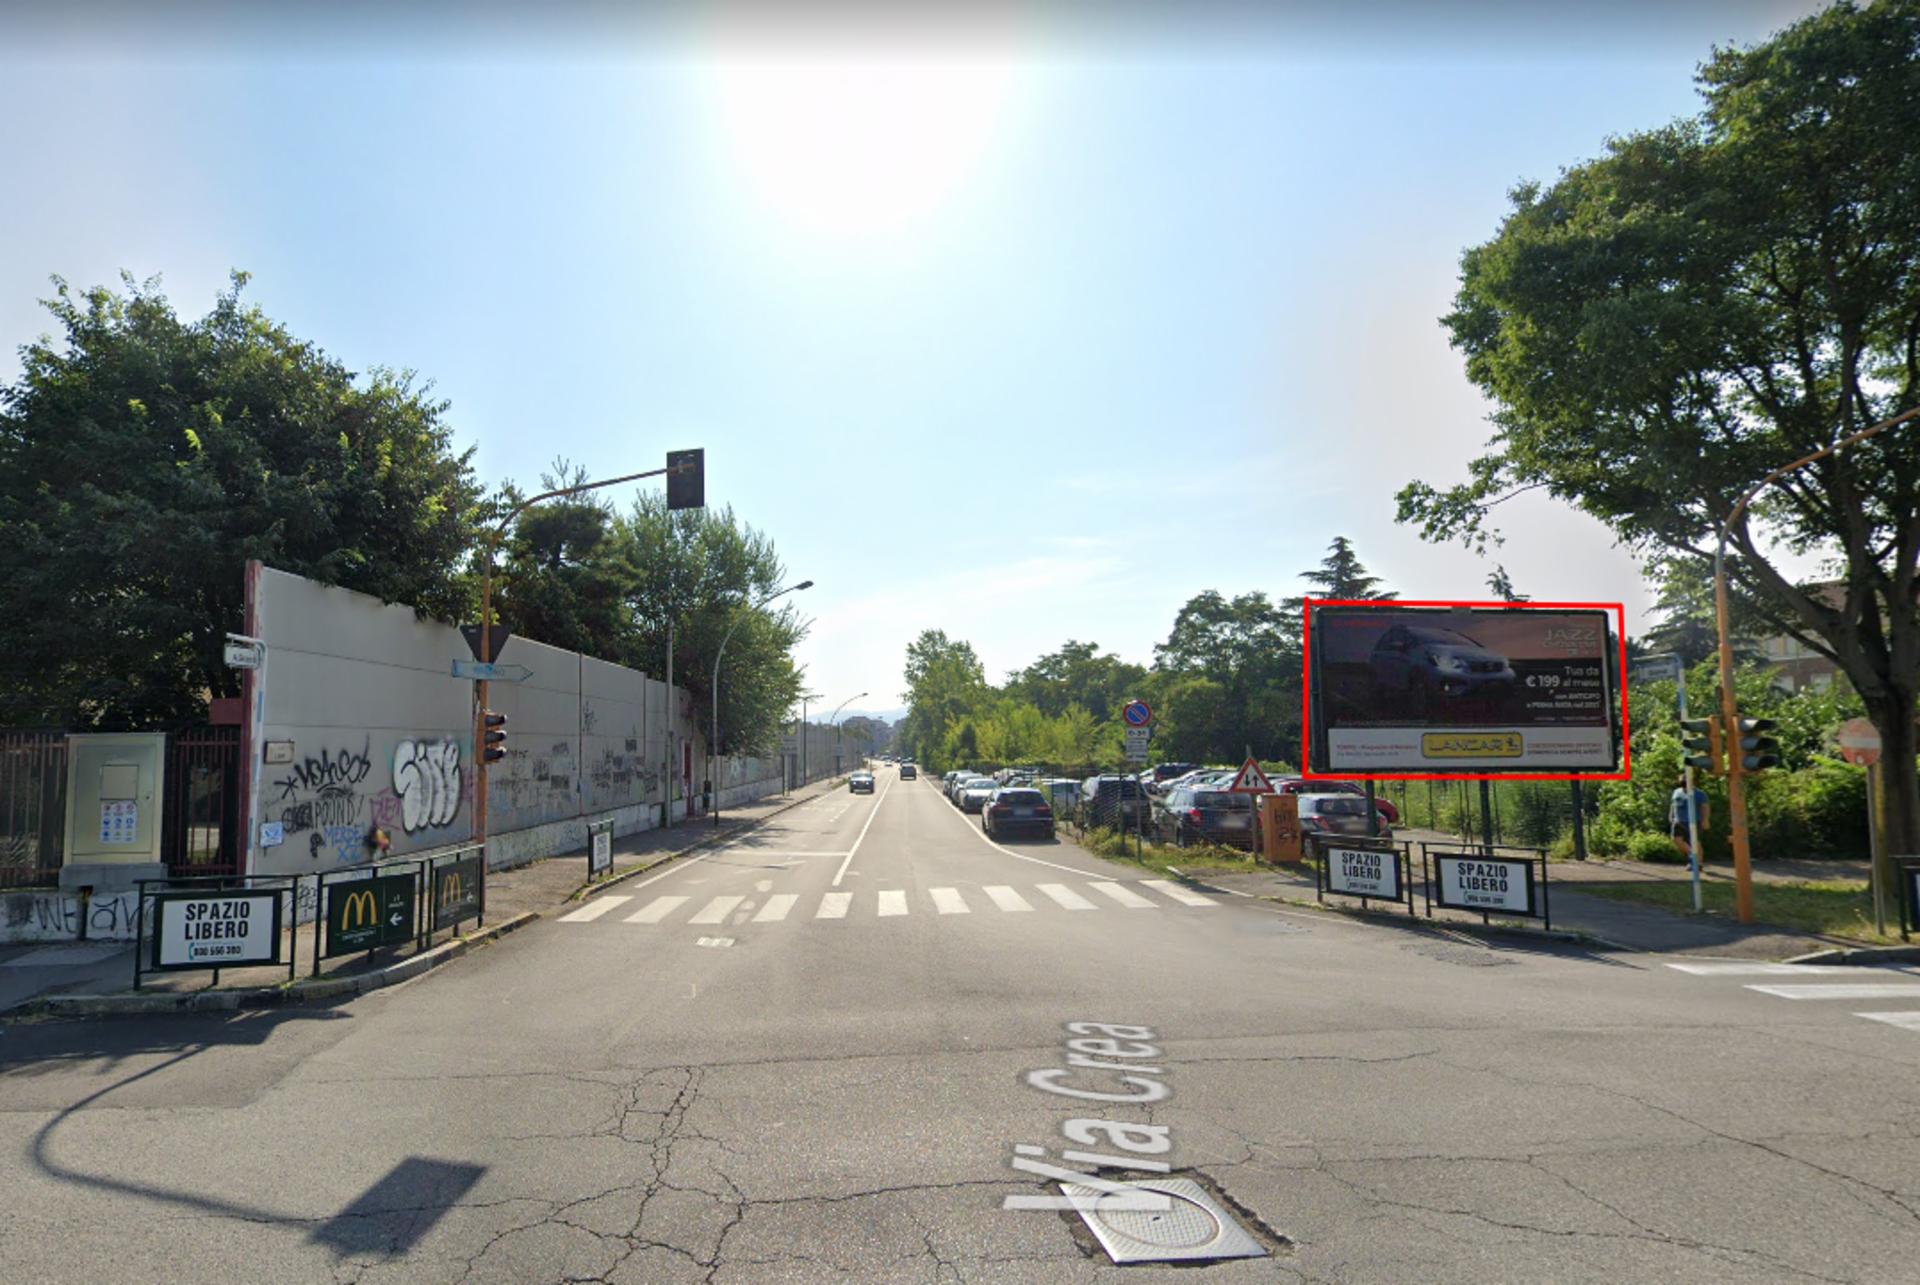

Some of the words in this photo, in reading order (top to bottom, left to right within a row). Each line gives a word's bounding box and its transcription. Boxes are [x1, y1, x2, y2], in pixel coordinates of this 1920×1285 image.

[1544, 628, 1596, 640] JAZZ
[1564, 666, 1583, 676] Tua
[1585, 666, 1599, 676] da
[1538, 675, 1561, 687] 199
[1342, 852, 1381, 867] SPAZIO
[1343, 865, 1382, 880] LIBERO
[1458, 862, 1508, 878] SPAZIO
[1459, 877, 1508, 893] LIBERO
[185, 901, 250, 921] SPAZIO
[184, 920, 249, 940] LIBERO
